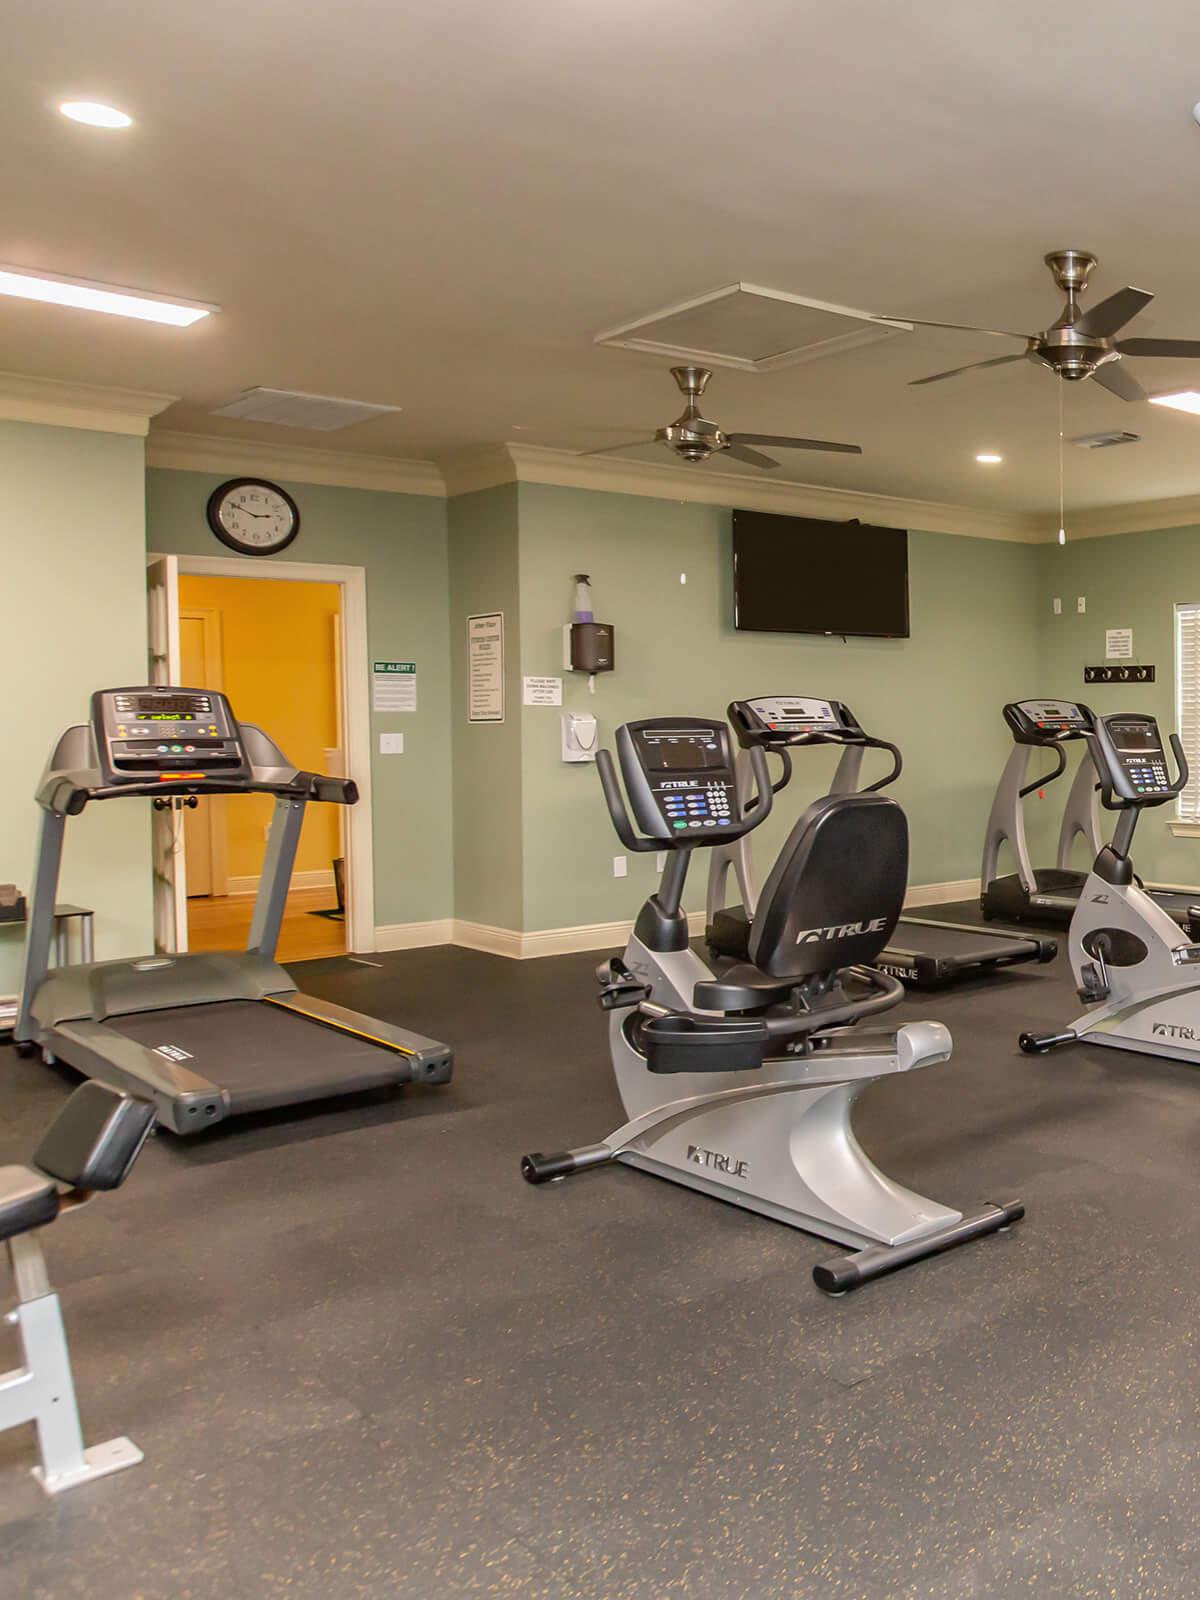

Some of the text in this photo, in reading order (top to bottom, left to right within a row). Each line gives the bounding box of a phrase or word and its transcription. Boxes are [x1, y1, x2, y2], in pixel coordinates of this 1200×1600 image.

[823, 917, 887, 940] TRUE
[889, 966, 919, 980] TRUE
[703, 1150, 748, 1179] TRUE
